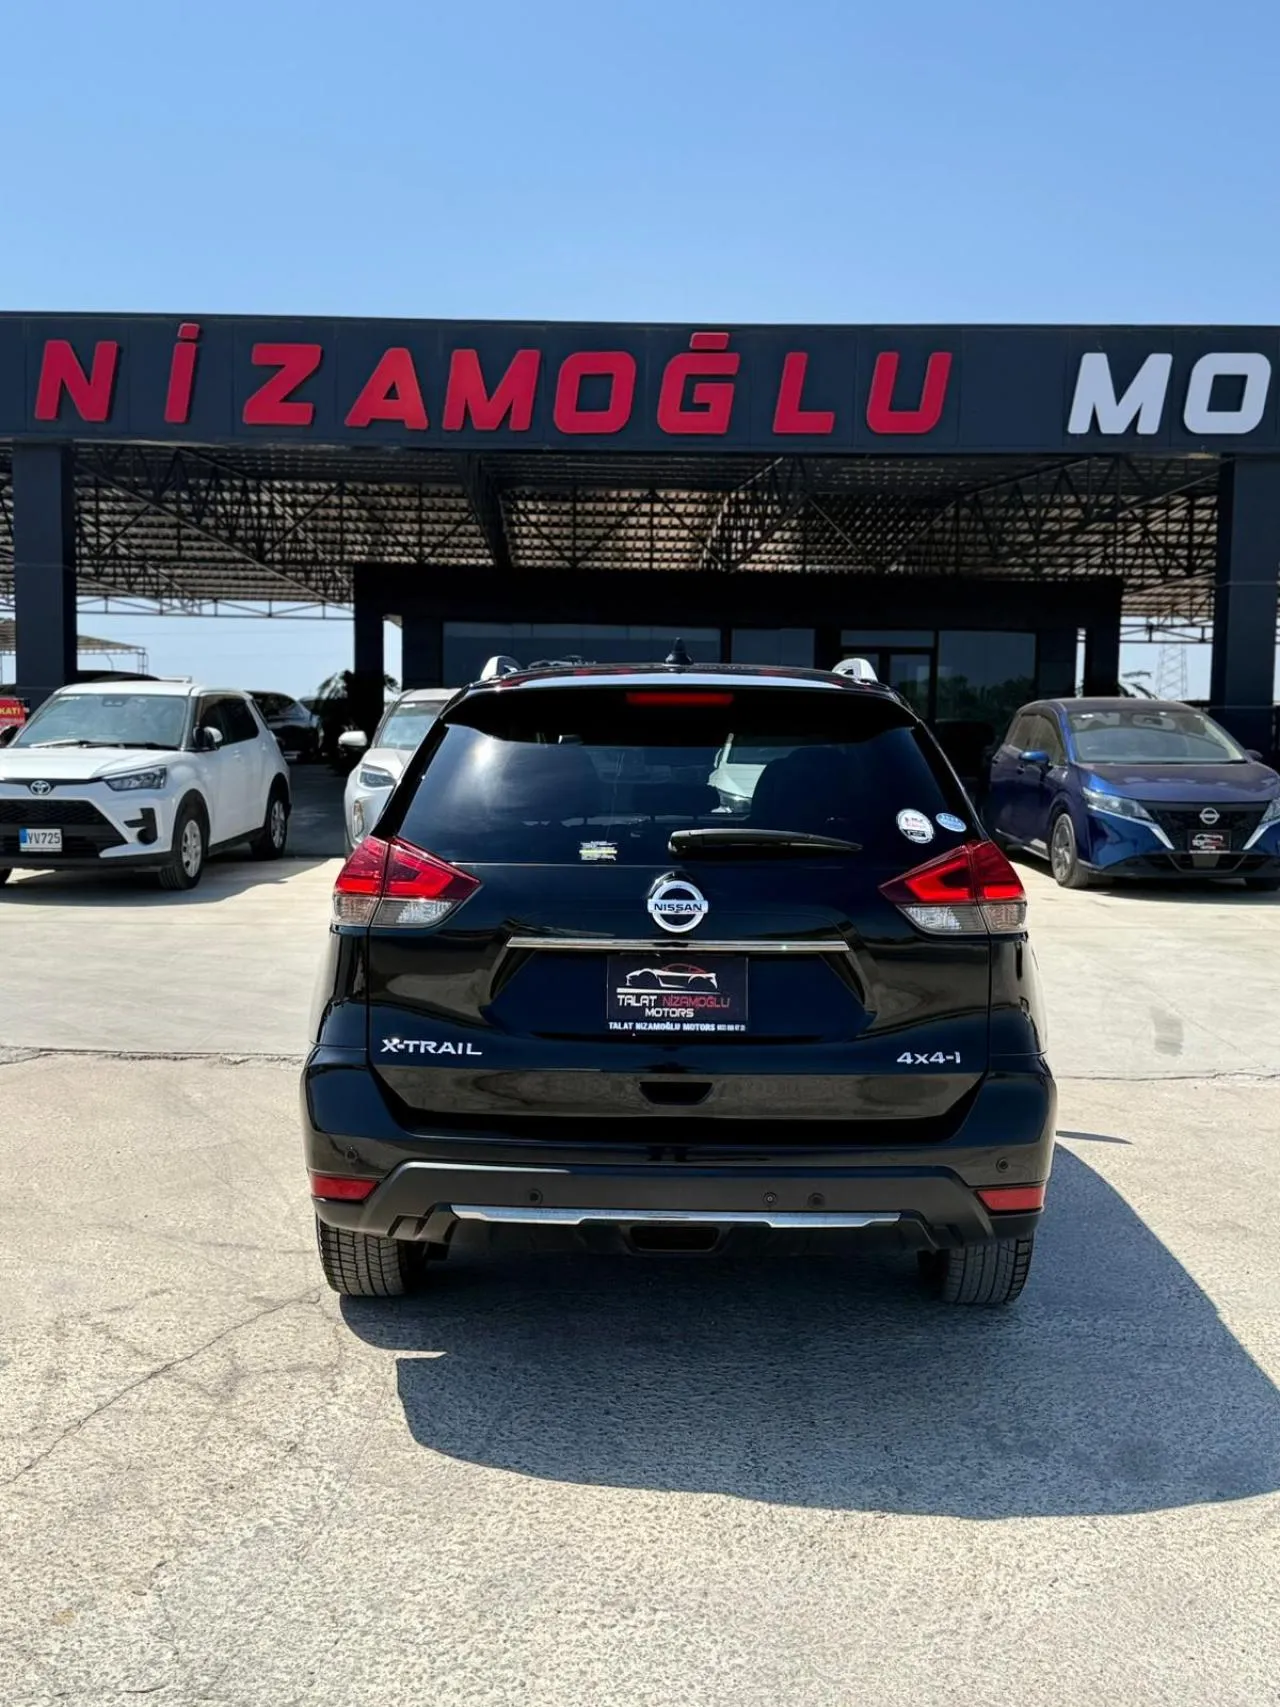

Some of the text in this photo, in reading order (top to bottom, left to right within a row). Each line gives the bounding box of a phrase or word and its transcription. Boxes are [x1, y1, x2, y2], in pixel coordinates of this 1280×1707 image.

[34, 322, 954, 435] NİZAMOĞLU
[654, 903, 703, 912] NISSAN
[617, 995, 657, 1007] TALAT
[645, 1008, 694, 1018] MOTORS
[608, 1022, 634, 1030] TALAT
[683, 1023, 715, 1031] MOTORS
